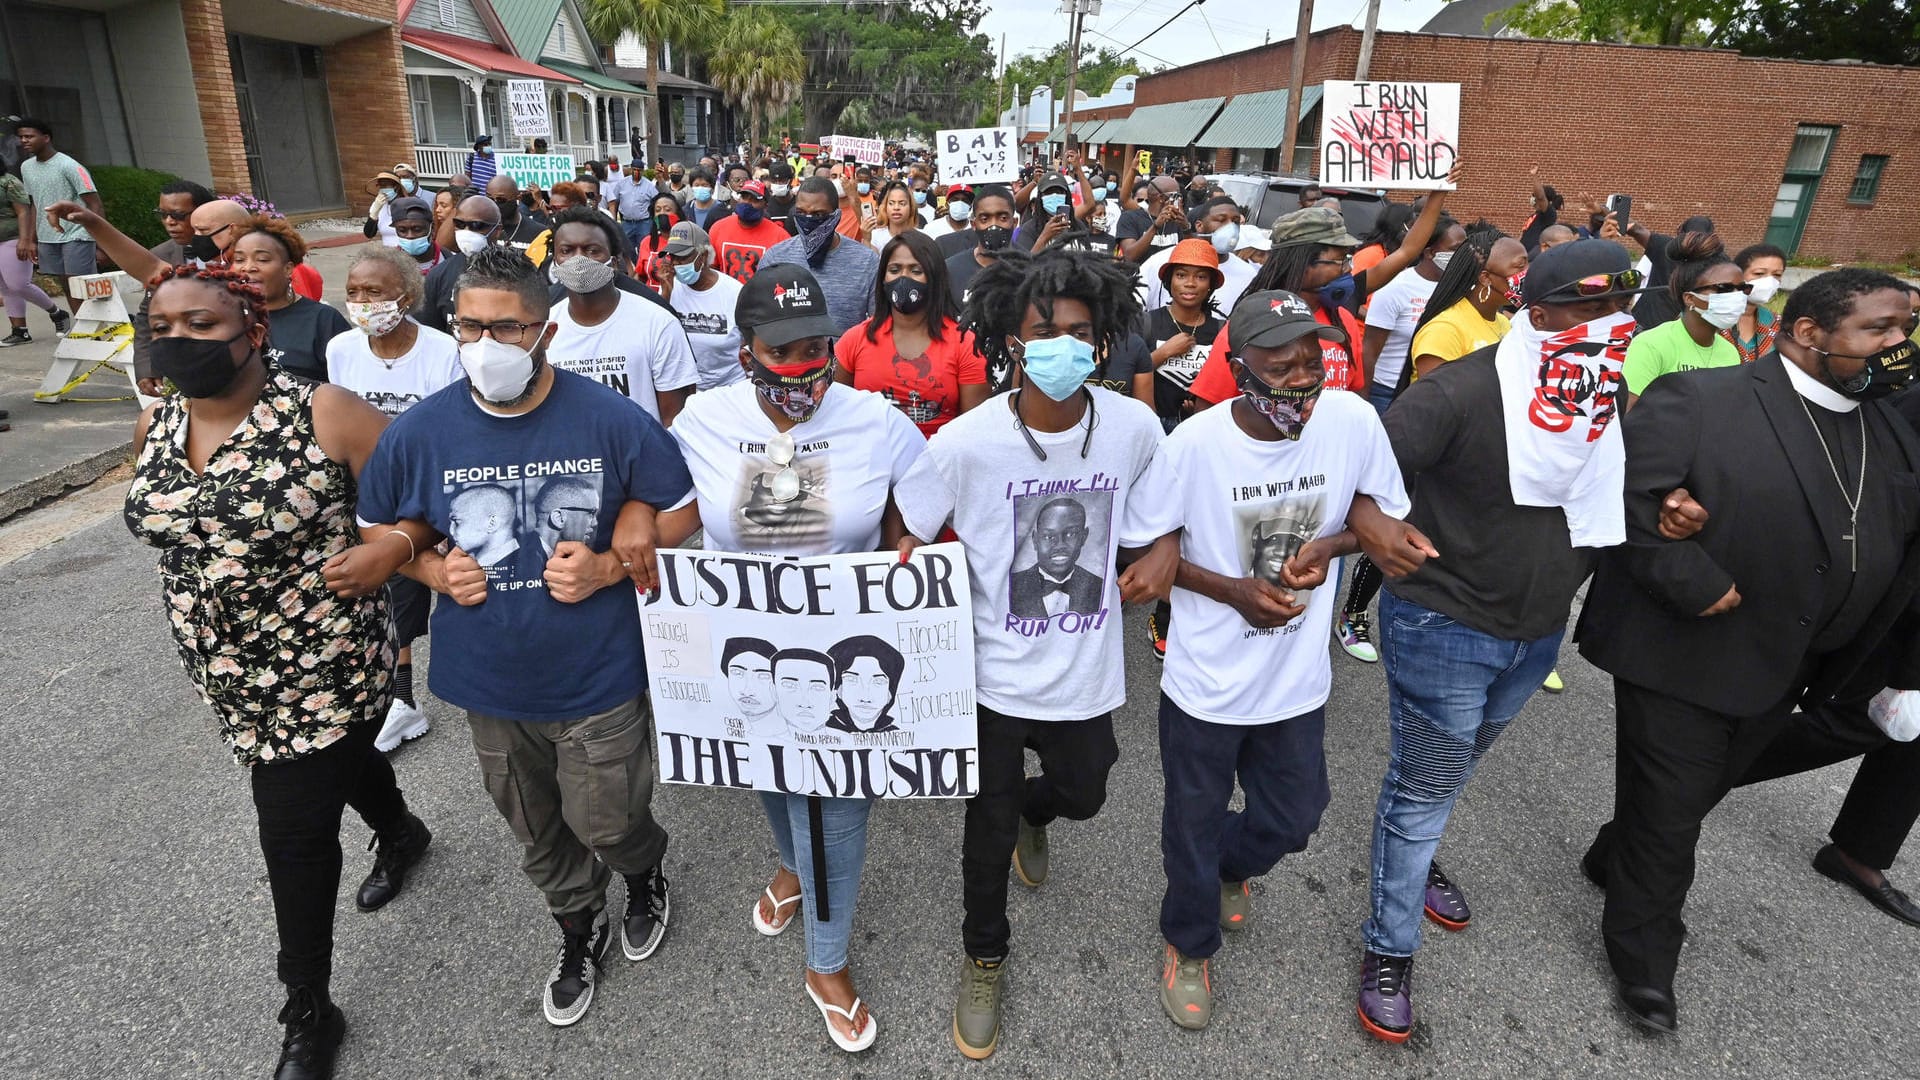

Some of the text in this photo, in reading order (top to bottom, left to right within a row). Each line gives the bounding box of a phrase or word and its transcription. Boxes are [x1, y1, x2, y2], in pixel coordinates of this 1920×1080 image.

[511, 82, 542, 93] JUSTICE!
[525, 92, 542, 102] ANY
[1353, 83, 1428, 110] I RUN
[511, 102, 545, 117] MEANS
[1349, 110, 1428, 140] WITH
[835, 137, 866, 149] JUSTICE
[866, 141, 882, 151] FOR
[501, 156, 572, 170] JUSTICE FOR
[1325, 141, 1456, 183] AHMAUD
[86, 278, 113, 297] COB
[579, 358, 594, 366] NOT
[595, 355, 626, 365] SATISFIED
[602, 363, 625, 372] RALLY
[1339, 363, 1348, 381] it
[747, 442, 767, 454] RUN
[801, 440, 830, 454] MAUD
[444, 458, 604, 485] PEOPLE CHANGE
[1005, 481, 1014, 500] I
[1022, 479, 1082, 498] THINK
[1232, 473, 1326, 502] I RUN WITH MAUD
[509, 581, 523, 590] UP
[526, 579, 543, 588] ON
[850, 553, 959, 615] FOR
[647, 613, 689, 643] ENOUGH
[1004, 607, 1109, 638] RUN ON!
[896, 620, 959, 654] ENOUGH
[660, 649, 681, 668] IS
[913, 655, 937, 684] IS
[896, 688, 974, 724] ENOUGH!!!
[661, 731, 978, 800] THE UNJUSTICE
